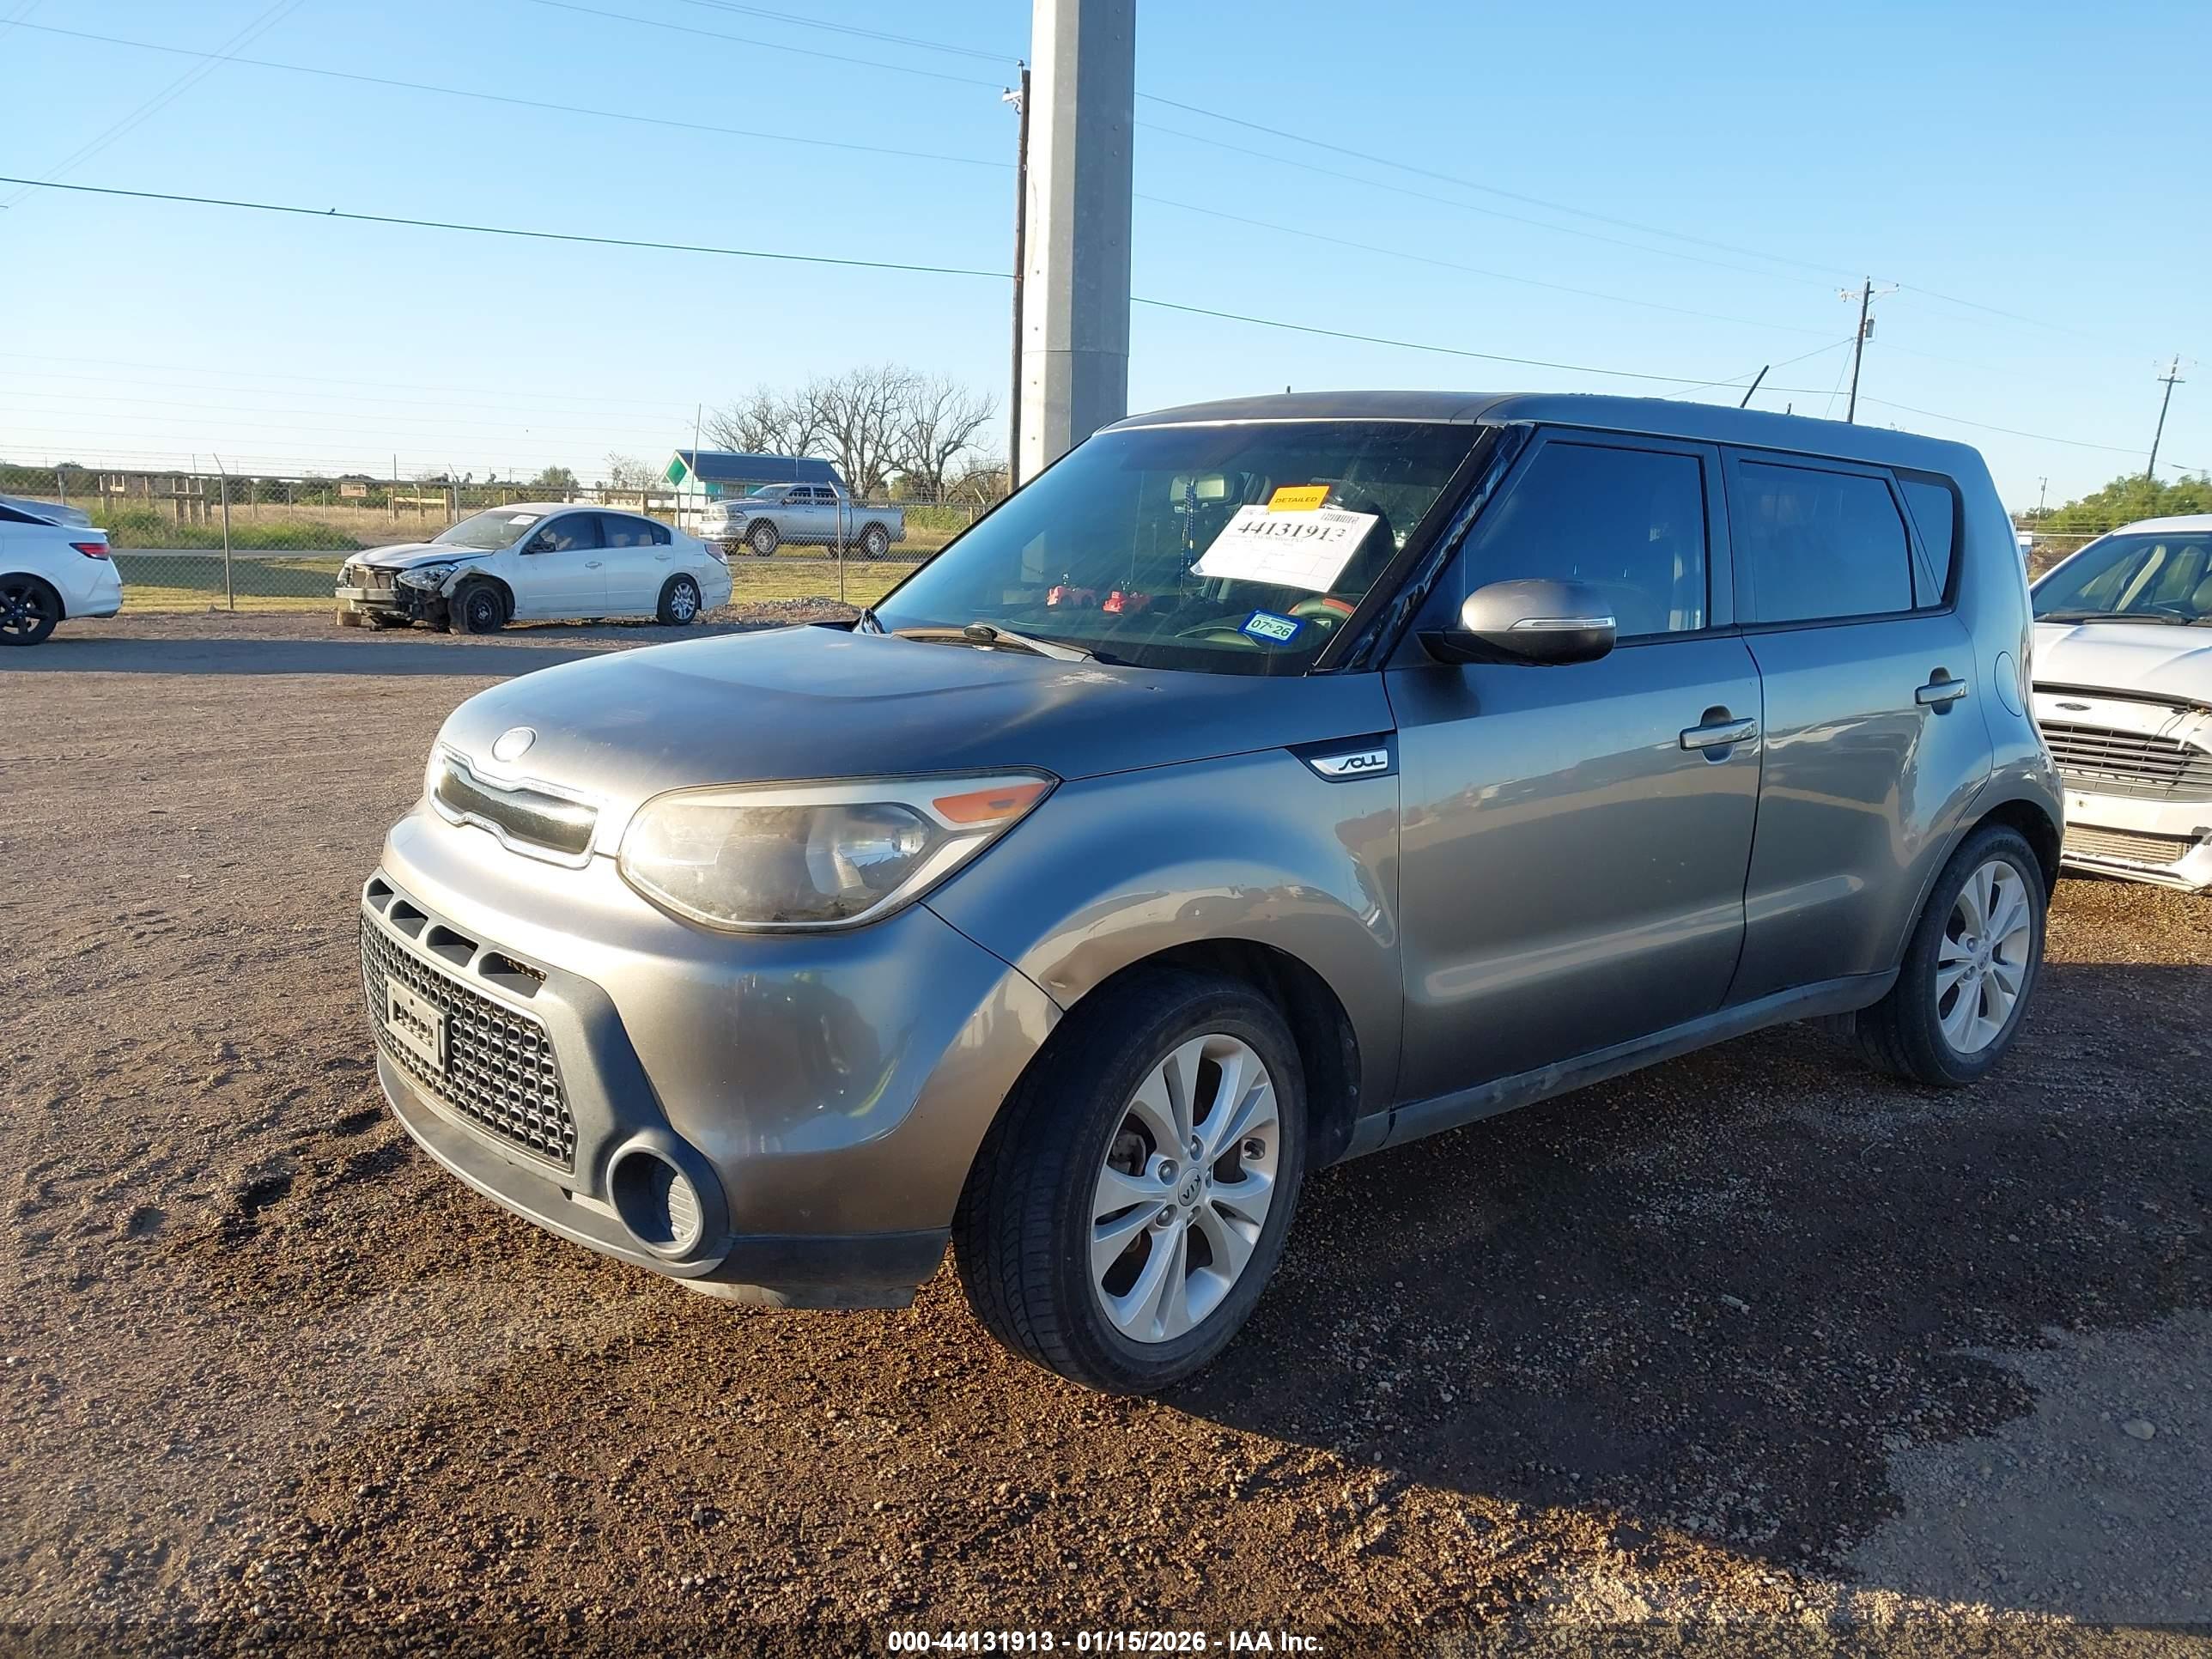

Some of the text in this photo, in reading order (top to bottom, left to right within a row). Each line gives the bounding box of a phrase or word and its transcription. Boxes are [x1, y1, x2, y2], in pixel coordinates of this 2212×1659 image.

[1251, 619, 1269, 630] 07
[1272, 625, 1292, 637] 26
[1338, 755, 1386, 771] SOUL
[1182, 1174, 1201, 1200] KIA
